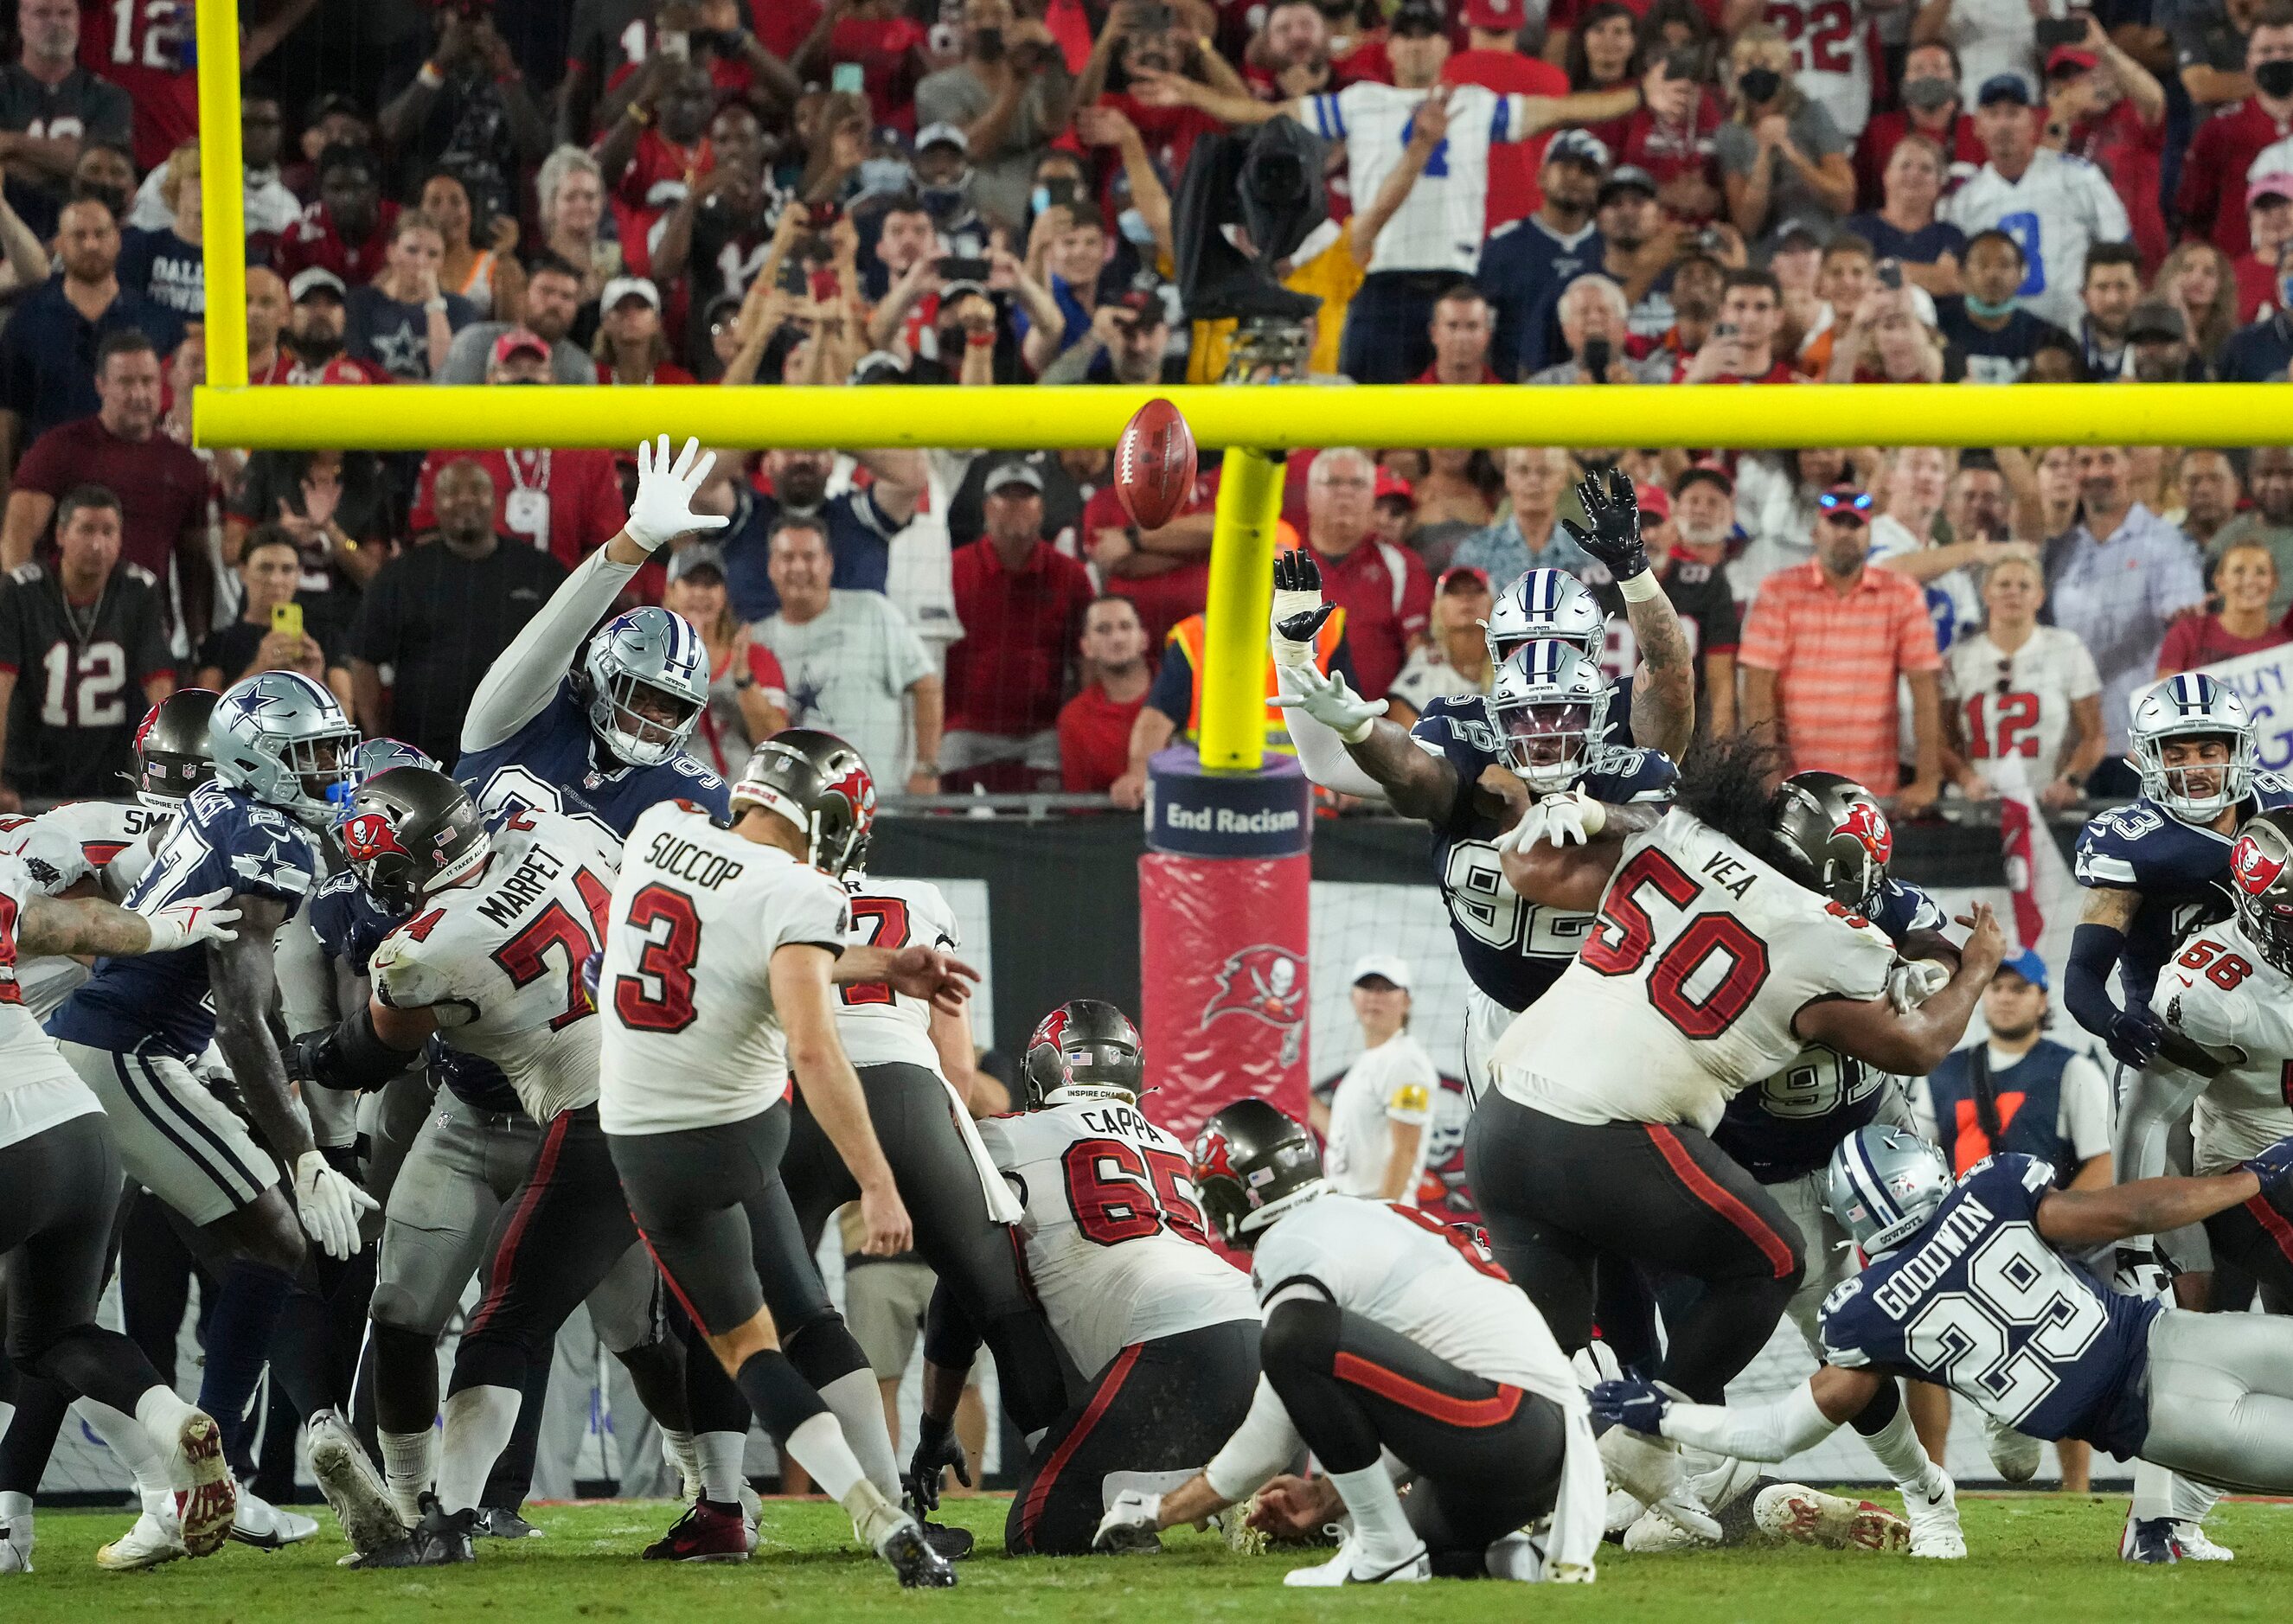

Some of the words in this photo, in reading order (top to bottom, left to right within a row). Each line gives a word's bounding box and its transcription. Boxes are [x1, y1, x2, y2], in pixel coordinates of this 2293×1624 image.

[42, 641, 126, 727] 12
[1966, 692, 2039, 758] 12
[144, 796, 172, 809] INSPIRE
[1168, 802, 1212, 832] End
[1217, 807, 1299, 834] Racism
[454, 856, 474, 872] TAKES
[474, 848, 483, 858] ALL
[477, 842, 565, 930] MARPET
[644, 832, 744, 892] SUCCOP
[1701, 851, 1758, 902] VEA
[613, 880, 702, 1035] 3
[1579, 844, 1771, 1041] 50
[2178, 939, 2253, 992] 56
[1080, 1107, 1164, 1144] CAPPA
[1060, 1137, 1212, 1248] 65
[1872, 1191, 1995, 1321] GOODWIN
[1880, 1215, 1923, 1244] COWBOYS
[1904, 1220, 2110, 1428] 29
